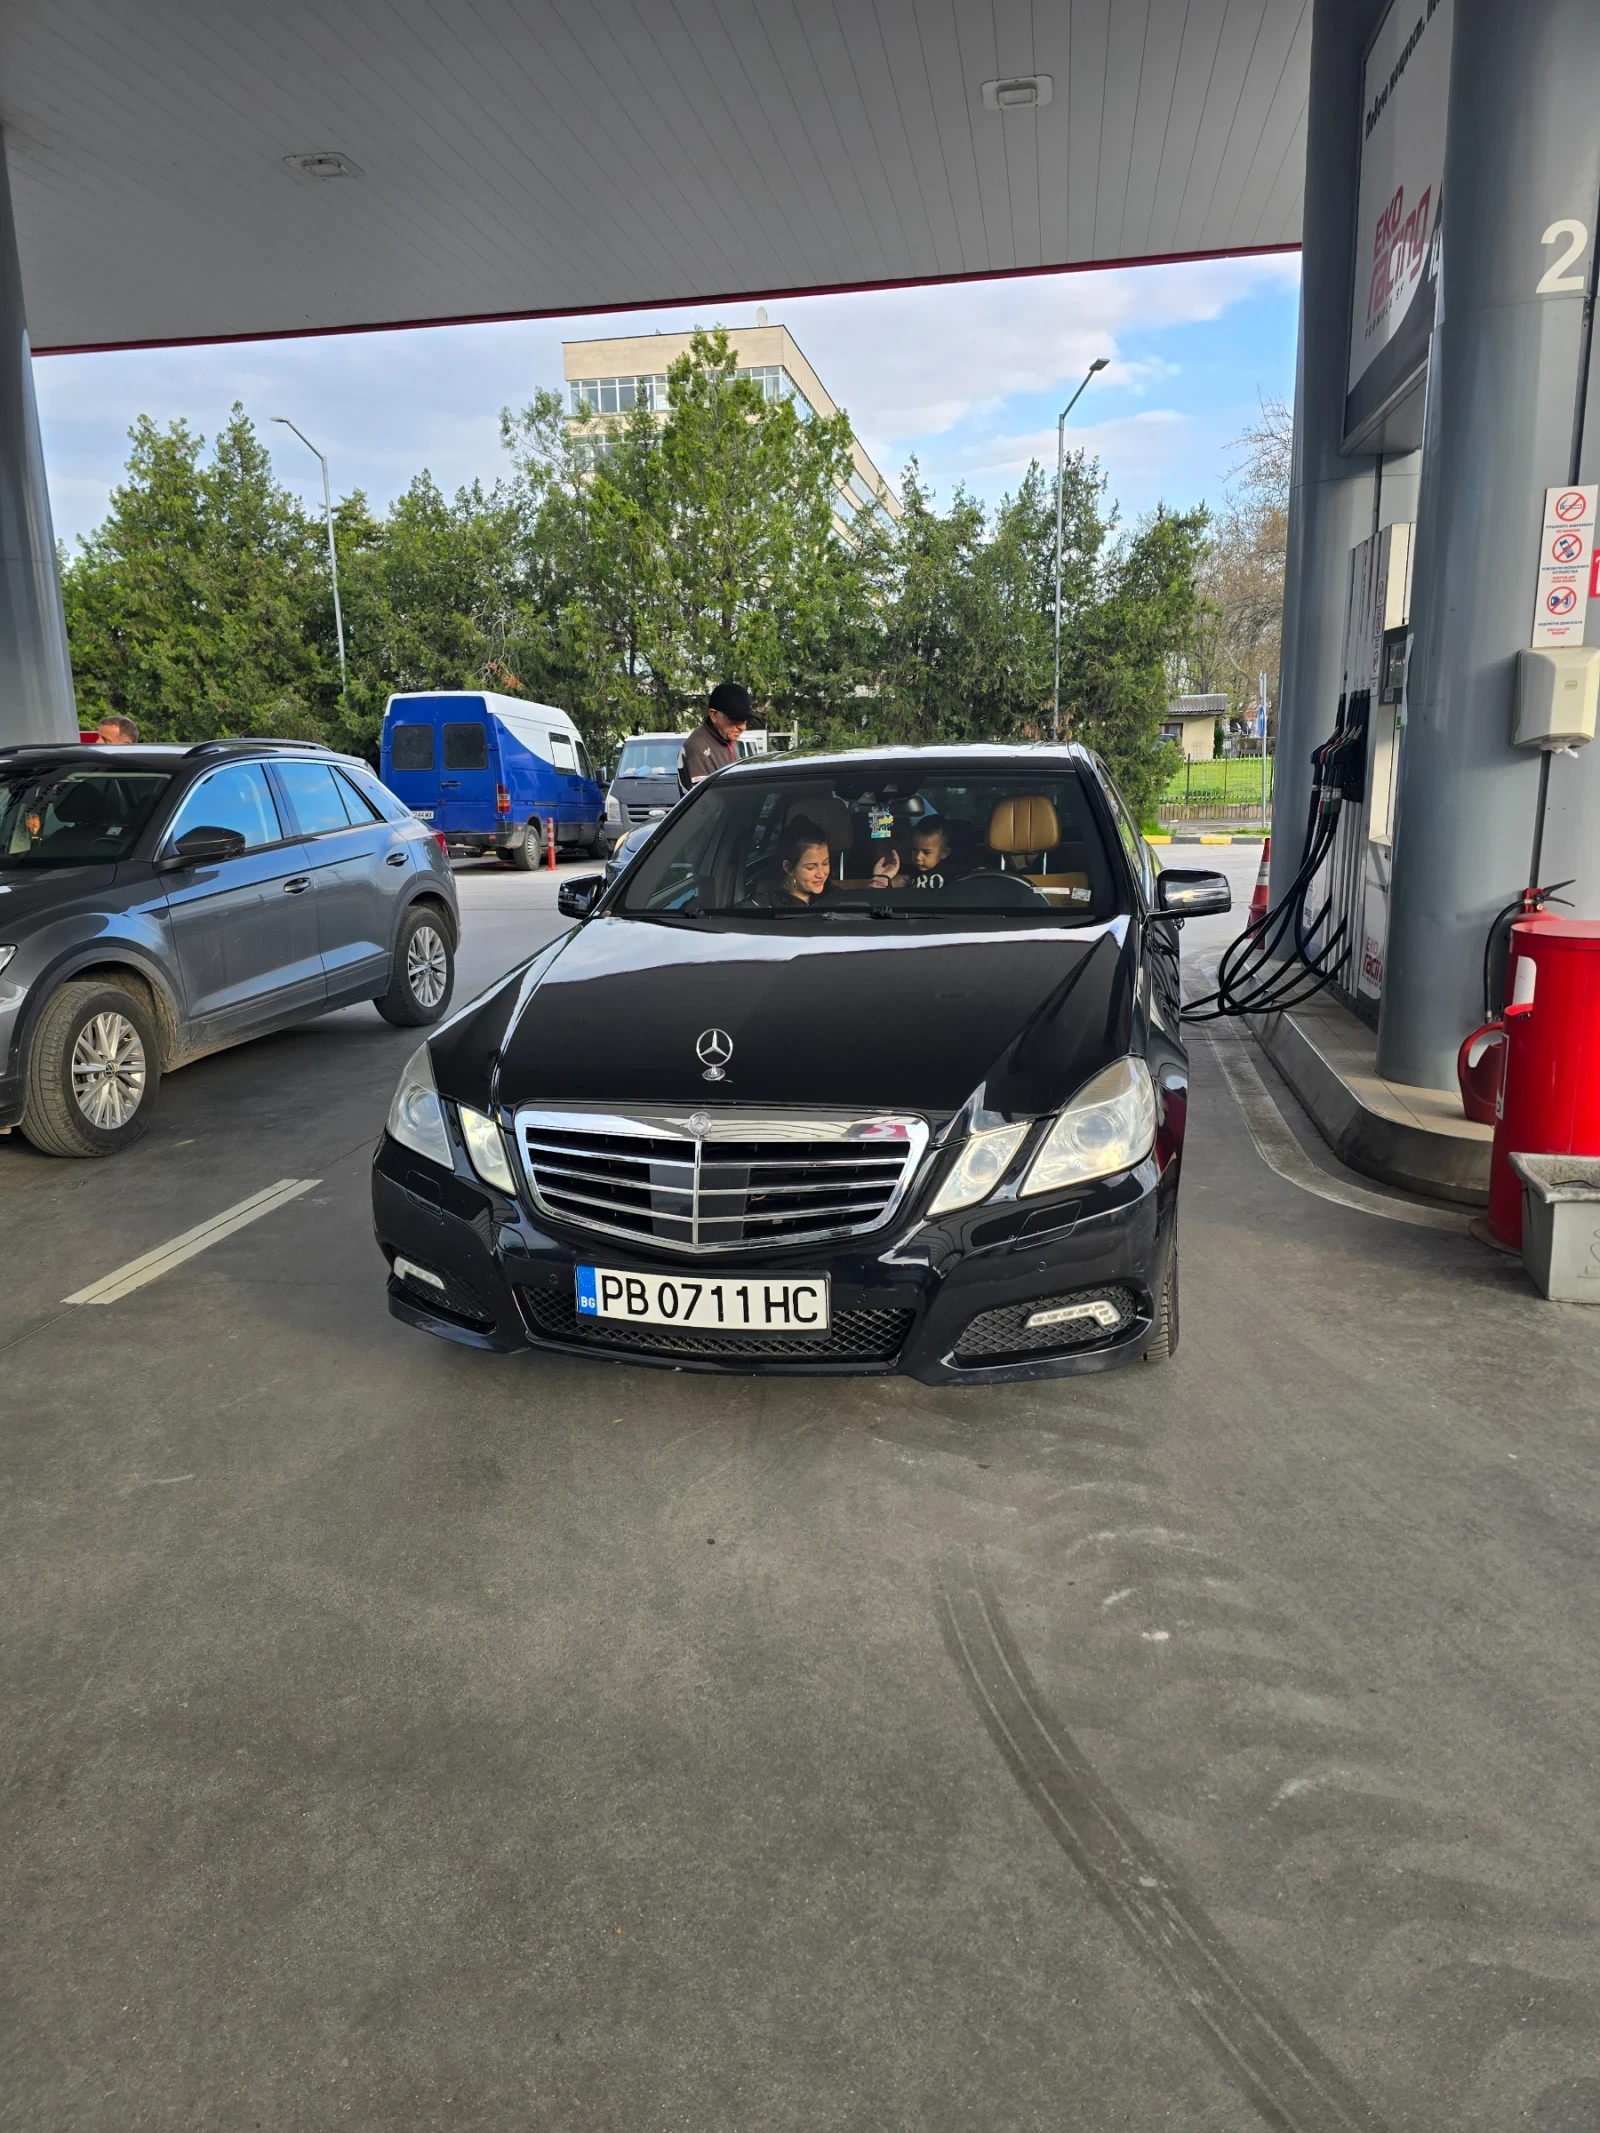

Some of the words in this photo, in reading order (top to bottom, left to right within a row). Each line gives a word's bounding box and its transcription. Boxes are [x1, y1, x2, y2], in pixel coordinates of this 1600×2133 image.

[1373, 184, 1404, 262] EKO
[1367, 184, 1432, 322] racing
[1535, 218, 1588, 294] 2
[911, 873, 944, 889] RO
[1366, 936, 1379, 955] EKO
[1363, 953, 1383, 982] racin
[580, 1296, 596, 1309] BG
[601, 1275, 649, 1316] PB
[657, 1281, 750, 1324] 0711
[763, 1285, 818, 1324] HC
